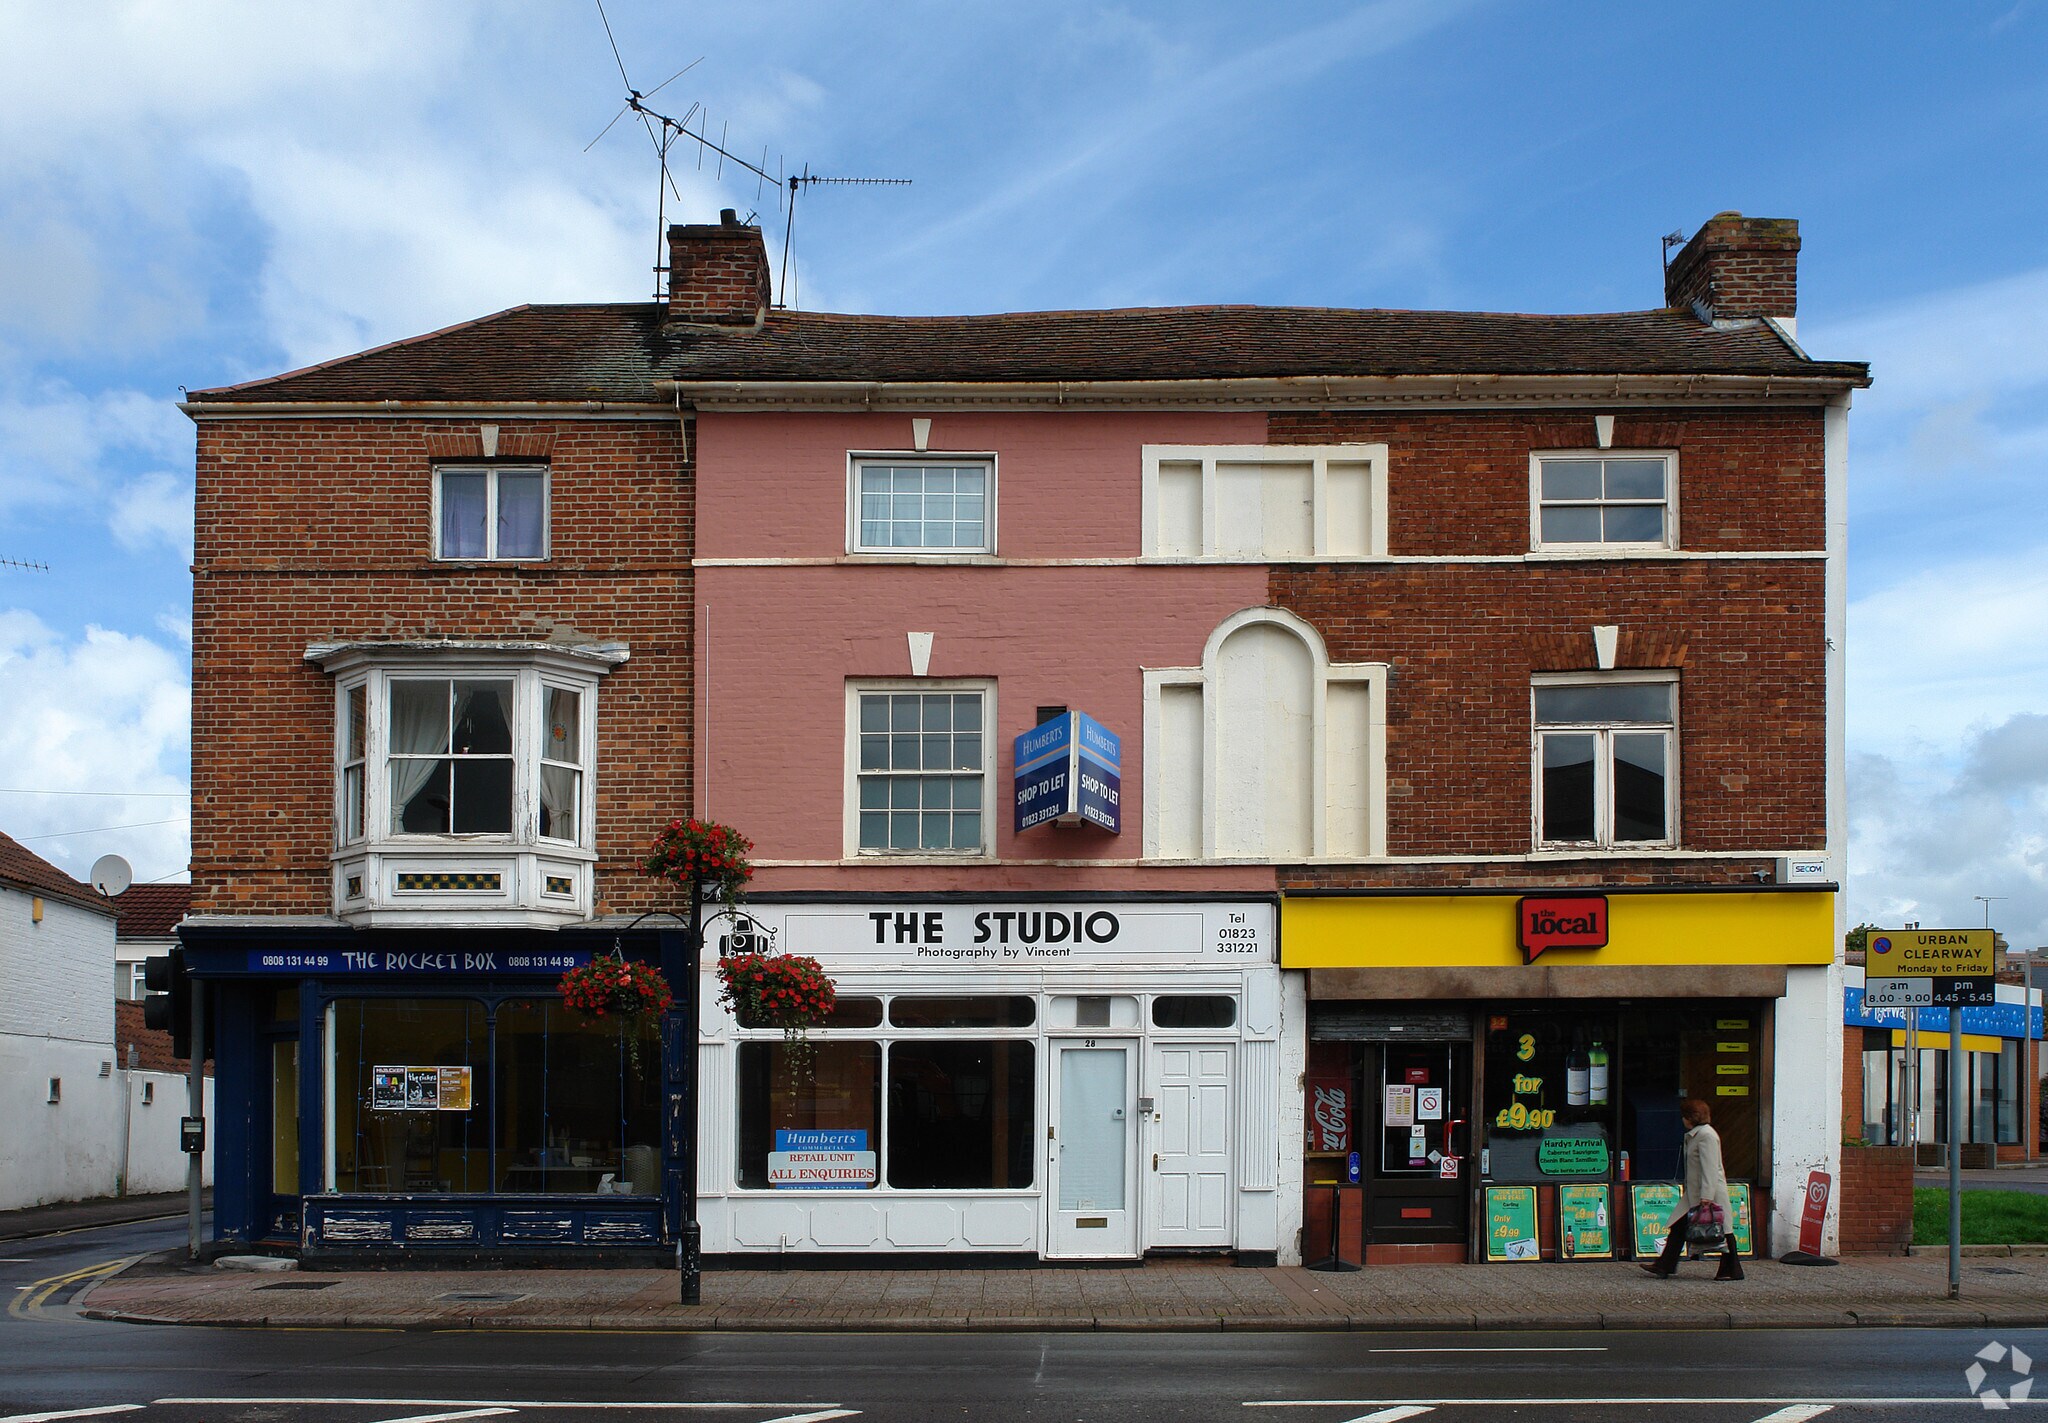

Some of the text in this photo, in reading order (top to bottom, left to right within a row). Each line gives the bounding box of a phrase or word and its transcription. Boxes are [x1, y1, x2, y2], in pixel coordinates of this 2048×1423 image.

[1023, 726, 1063, 756] HUMBERTS
[1086, 725, 1116, 757] HUMBERTS
[1018, 773, 1065, 805] SHOP TO LET
[1081, 774, 1119, 805] SHOP TO LET
[1022, 804, 1059, 827] 01823 331234
[1084, 804, 1098, 820] 01823
[1795, 865, 1822, 873] SECOM
[1228, 912, 1245, 923] Tel
[869, 911, 1121, 944] THE STUDIO
[1531, 912, 1598, 935] local
[1219, 928, 1256, 939] 01823
[1917, 935, 1968, 945] URBAN
[917, 947, 1071, 959] Photography by Vincent
[1216, 943, 1257, 953] 331221
[1903, 949, 1983, 959] CLEARWAY
[262, 956, 329, 966] 0808 131 44 99
[342, 952, 497, 970] THE ROCKET BOX
[508, 956, 575, 966] 0808 131 44 99
[1897, 962, 1988, 973] Monday to Friday
[1889, 982, 1909, 990] am
[1954, 981, 1974, 991] pm
[1868, 994, 1895, 1003] 8.00
[1904, 994, 1930, 1003] 9.00
[1934, 993, 1959, 1002] 4.45
[1969, 993, 1993, 1002] 5.45
[1516, 1033, 1536, 1061] 3
[1512, 1073, 1543, 1094] for
[787, 1133, 856, 1144] Humberts
[1544, 1139, 1603, 1148] Hardys Arrival
[789, 1153, 855, 1162] RETAIL UNIT
[769, 1168, 875, 1181] ALL ENQUIRIES
[1641, 1212, 1659, 1220] Only
